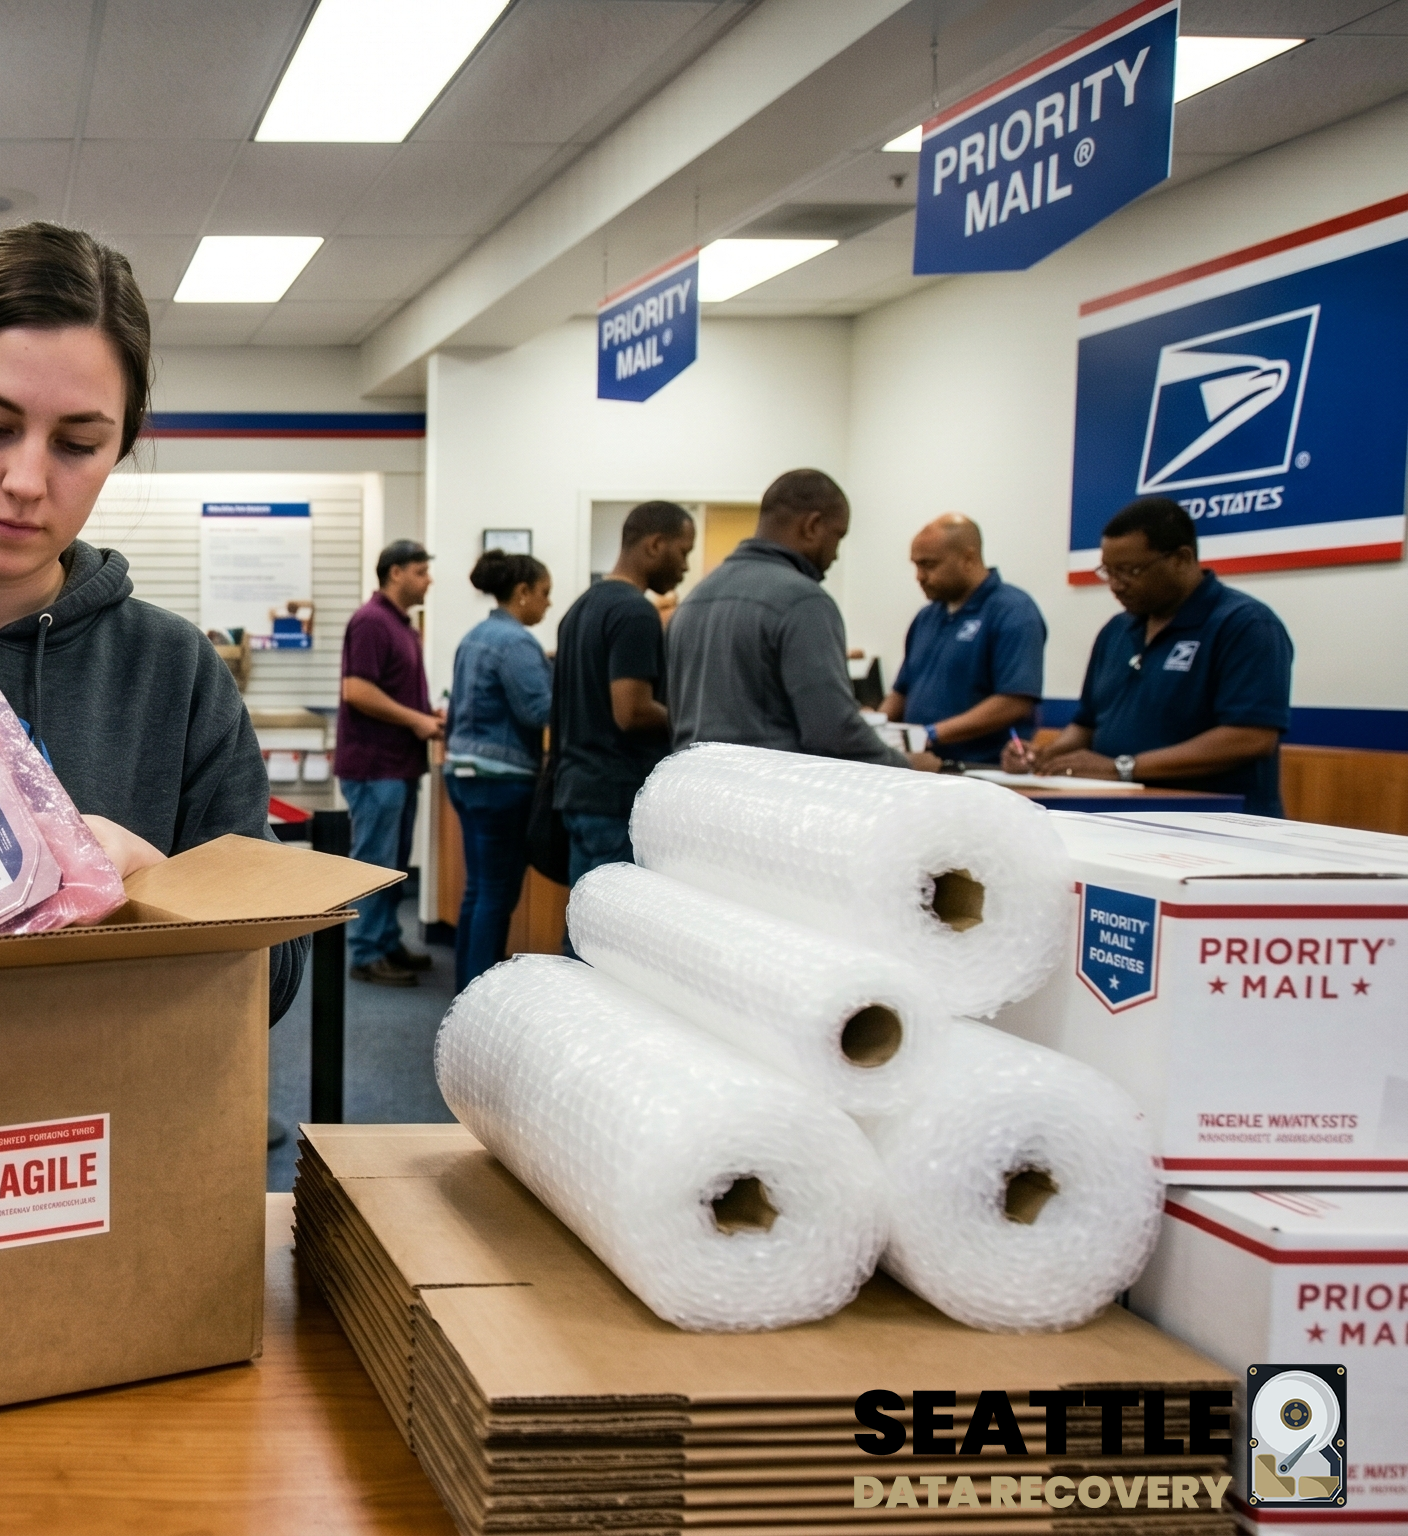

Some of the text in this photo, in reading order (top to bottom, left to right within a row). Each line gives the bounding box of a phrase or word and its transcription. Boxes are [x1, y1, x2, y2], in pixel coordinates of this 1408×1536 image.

[933, 45, 1151, 197] PRIORITY
[602, 278, 691, 351] PRIORITY
[1205, 486, 1285, 518] STATES
[1200, 938, 1387, 965] PRIORITY
[1241, 976, 1339, 999] MAIL
